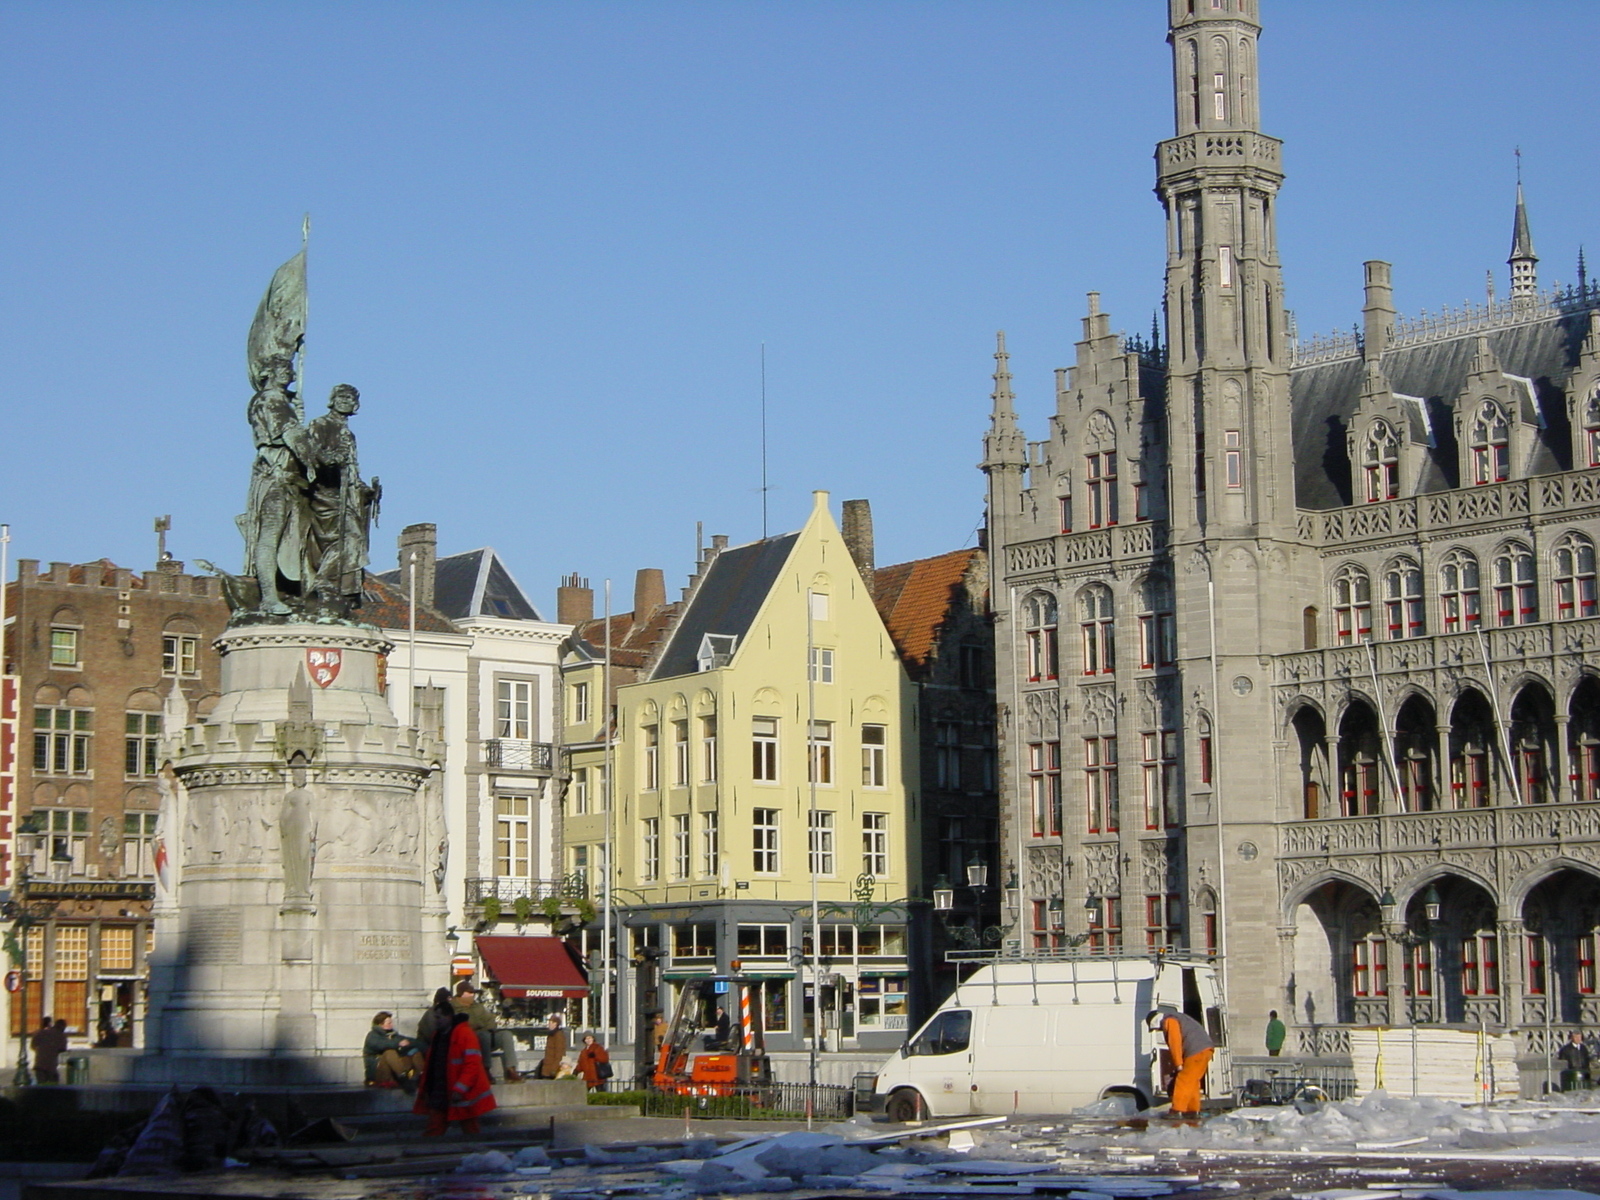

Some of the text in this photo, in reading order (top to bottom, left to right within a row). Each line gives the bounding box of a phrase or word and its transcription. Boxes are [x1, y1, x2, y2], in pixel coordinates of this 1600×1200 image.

[29, 883, 119, 893] RESTAURANT
[124, 884, 143, 893] LA
[526, 990, 563, 998] SOUVENIRS
